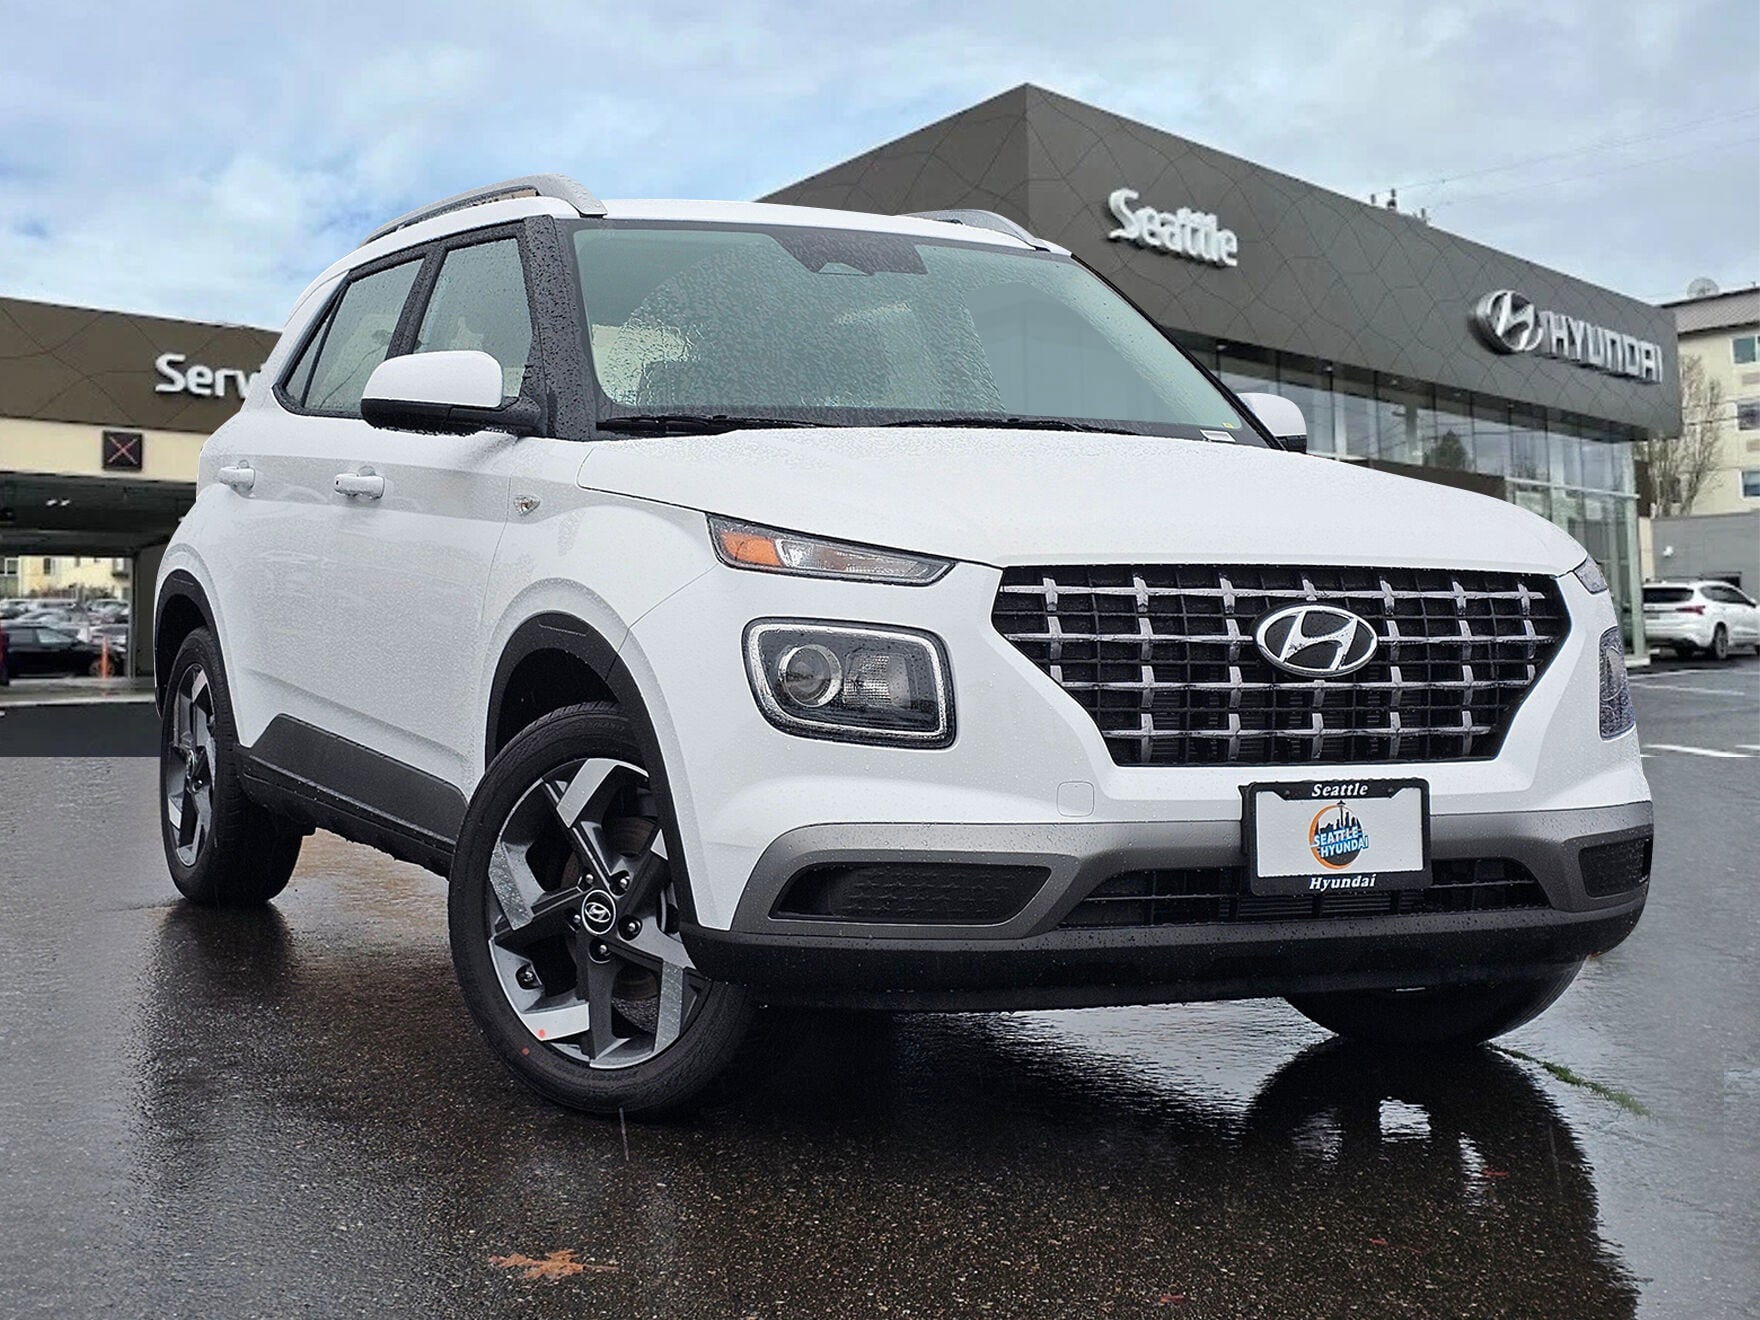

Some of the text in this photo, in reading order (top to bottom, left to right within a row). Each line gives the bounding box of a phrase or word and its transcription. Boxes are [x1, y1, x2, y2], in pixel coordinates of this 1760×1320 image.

[1109, 188, 1237, 266] Seattle
[1539, 311, 1663, 382] HYUNDAI
[1311, 783, 1369, 797] Seattle
[1314, 826, 1359, 847] SEATTLE
[1320, 834, 1369, 858] HYUNDAI
[1309, 873, 1377, 892] Hyundai
